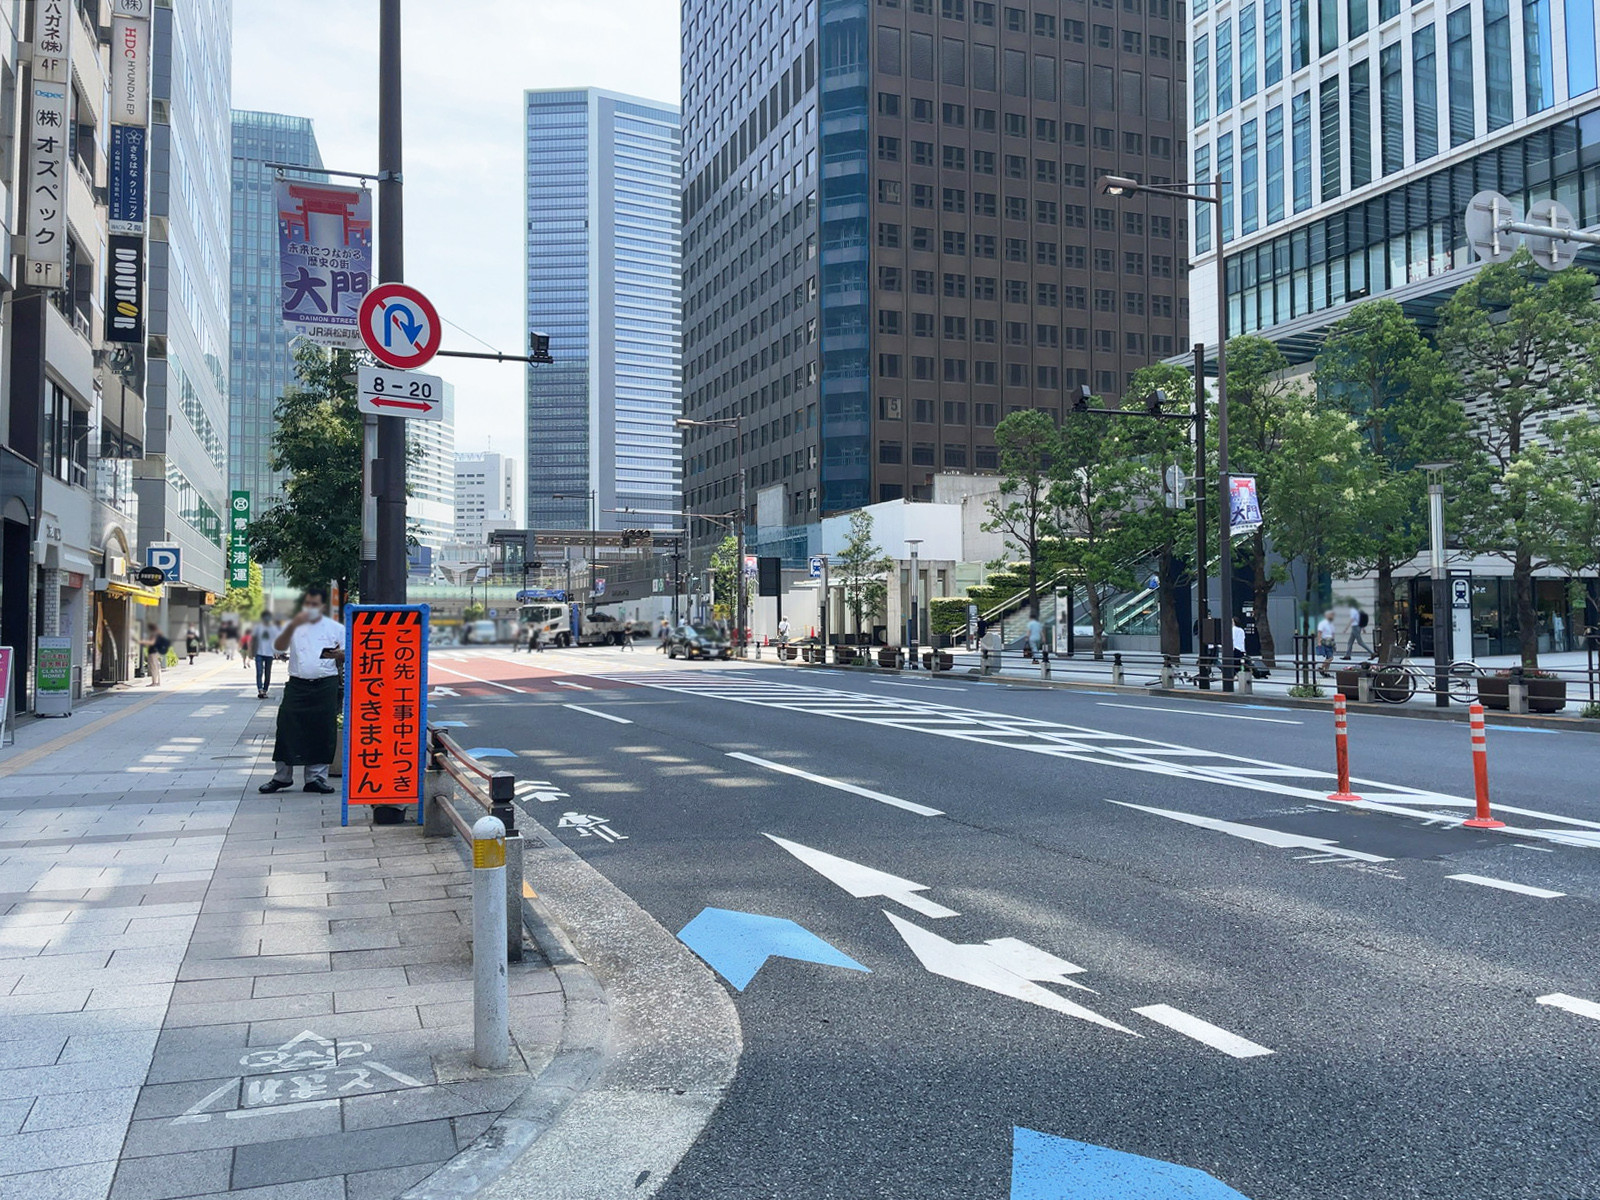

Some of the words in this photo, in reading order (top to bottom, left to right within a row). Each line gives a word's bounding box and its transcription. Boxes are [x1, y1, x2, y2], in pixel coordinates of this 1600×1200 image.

[41, 0, 62, 53] ハガネ(株)
[124, 27, 137, 59] HDC
[41, 59, 58, 71] 4F
[126, 61, 136, 102] HYUNDAI
[35, 90, 64, 99] Ospec
[126, 104, 135, 115] EP
[35, 263, 52, 274] 3F
[307, 256, 349, 269] 歴史の街
[114, 248, 138, 329] DOUTOR
[285, 266, 368, 314] 大門
[299, 314, 328, 322] DAIMON
[331, 316, 357, 324] STREET
[1232, 505, 1260, 522] 大門
[233, 517, 247, 581] 富士港運
[152, 551, 176, 570] P
[358, 628, 386, 794] 右折できません
